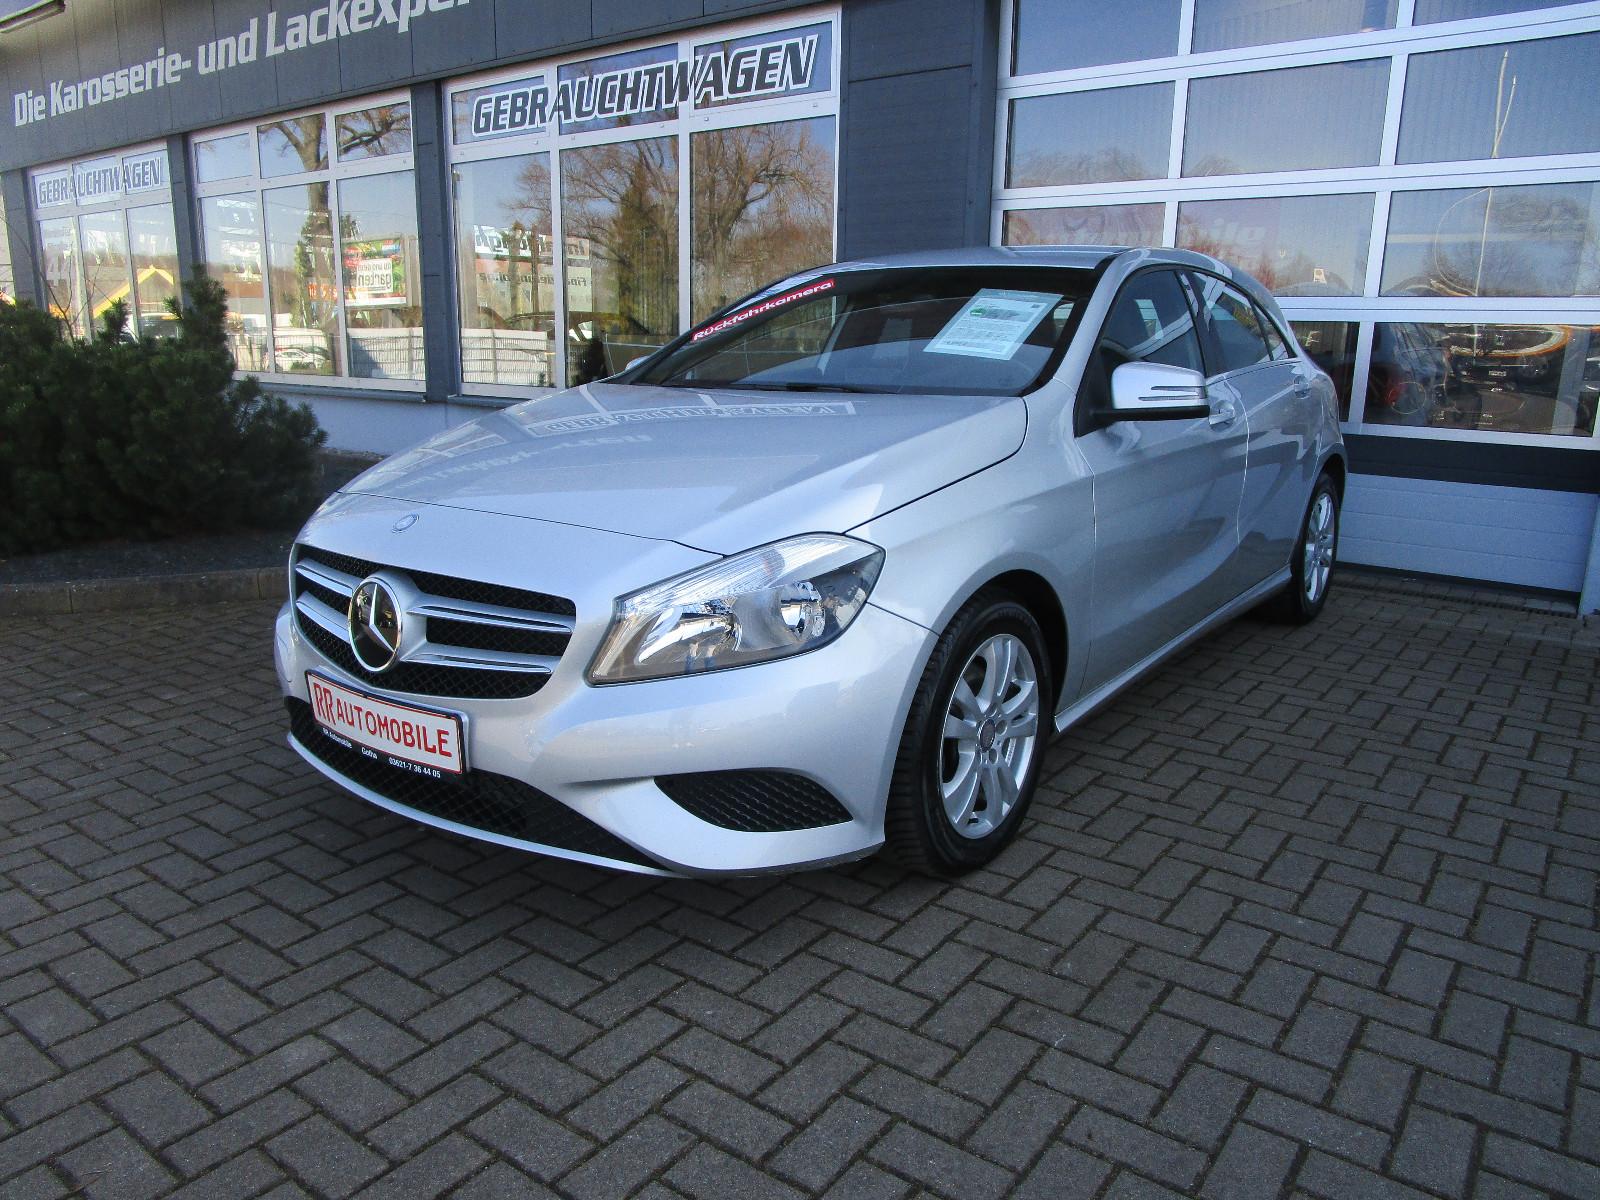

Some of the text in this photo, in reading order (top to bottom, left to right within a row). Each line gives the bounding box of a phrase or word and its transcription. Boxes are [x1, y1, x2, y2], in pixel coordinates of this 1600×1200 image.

[14, 91, 46, 127] Die
[50, 47, 191, 117] Karosserie-
[198, 17, 257, 76] und
[473, 34, 818, 136] GEBRAUCHTWAGEN
[38, 158, 160, 204] GEBRAUCHTWAGEN
[693, 282, 832, 342] Rückfahrkamera
[313, 682, 452, 757] RR AUTOMOBILE
[423, 767, 432, 776] 44
[432, 770, 441, 778] 05
